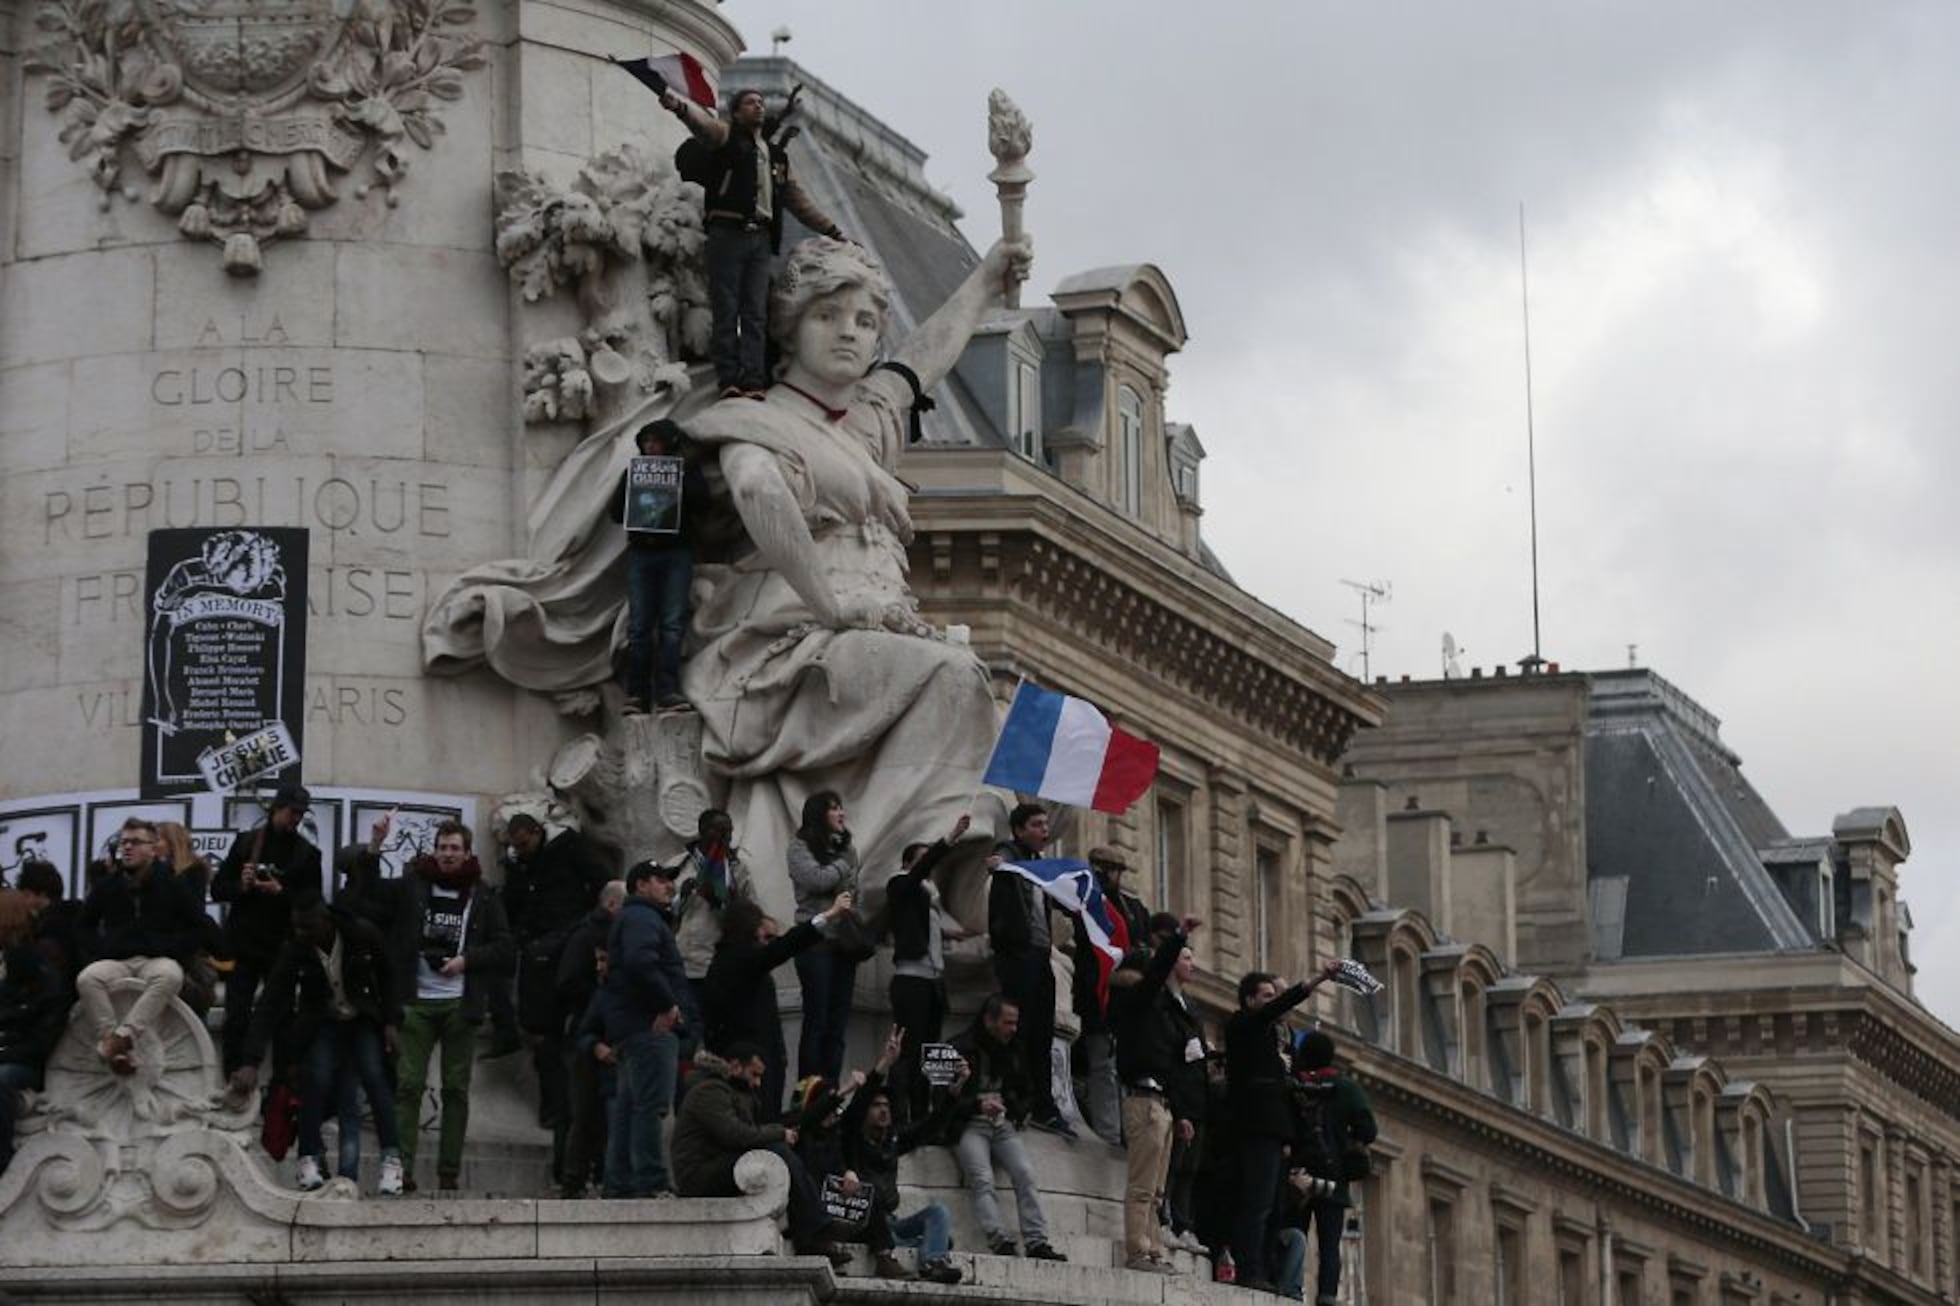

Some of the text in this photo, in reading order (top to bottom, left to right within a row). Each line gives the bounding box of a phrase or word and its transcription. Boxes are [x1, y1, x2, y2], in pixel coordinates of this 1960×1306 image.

[198, 314, 289, 342] A LA
[151, 367, 334, 404] GLOIRE
[193, 428, 290, 452] DE LA
[44, 474, 449, 546] RÉPUBLIQUE
[307, 687, 406, 725] ARIS
[211, 730, 280, 771] JE SUS
[192, 837, 227, 850] DIEU
